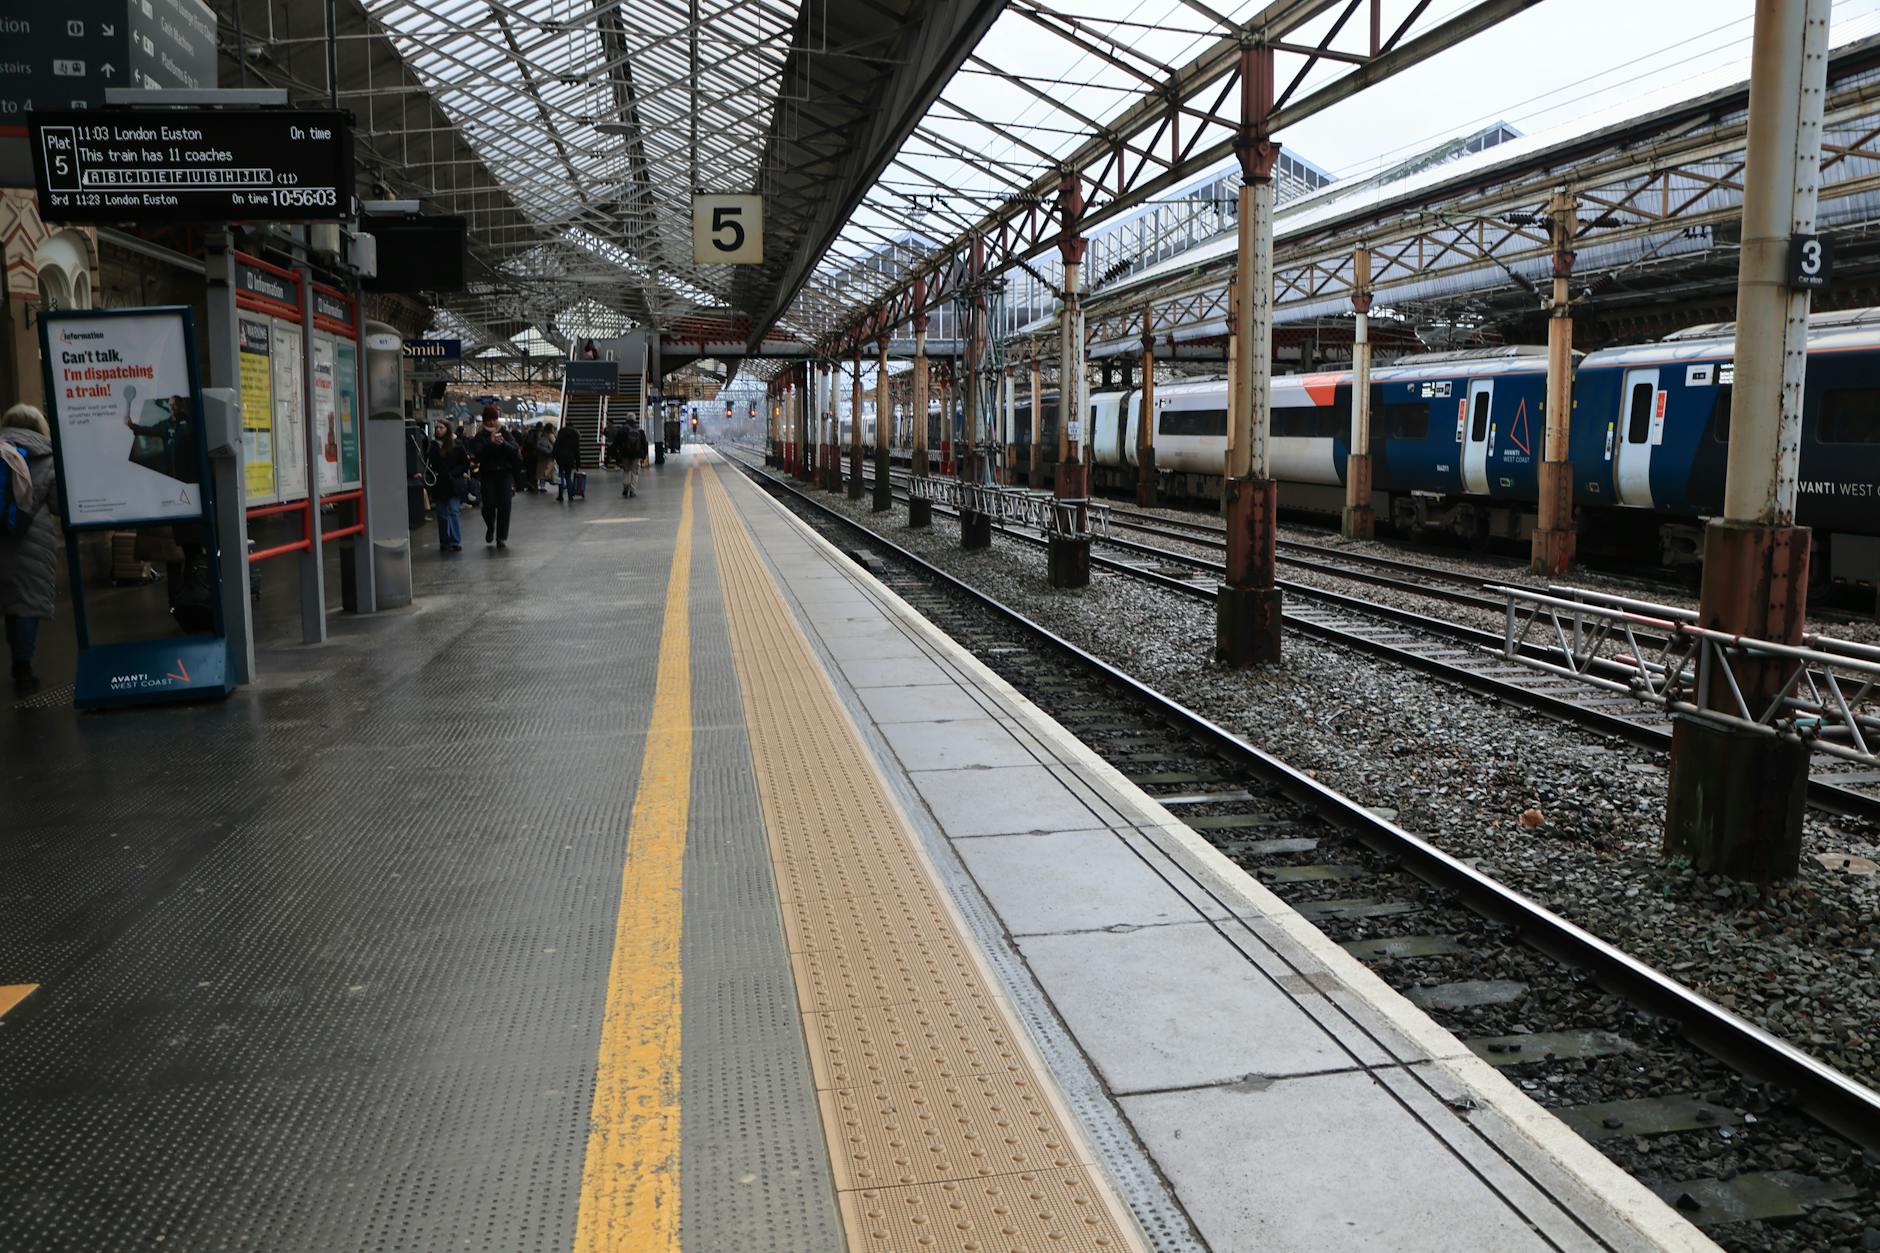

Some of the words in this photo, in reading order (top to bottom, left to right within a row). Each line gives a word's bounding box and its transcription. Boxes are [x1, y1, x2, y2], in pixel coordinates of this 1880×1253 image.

[1, 99, 18, 113] to
[23, 99, 34, 113] 4
[78, 126, 110, 141] 11:03
[114, 126, 157, 140] London
[161, 126, 202, 141] Euston
[291, 126, 305, 140] On
[310, 127, 332, 140] time
[47, 135, 72, 150] Plat
[80, 148, 104, 162] This
[108, 148, 138, 162] train
[142, 148, 164, 162] has
[169, 148, 180, 161] 11
[185, 148, 233, 162] coaches
[55, 155, 69, 176] 5
[277, 173, 297, 185] (11)
[50, 195, 69, 206] 3rd
[76, 195, 101, 206] 11:23
[105, 194, 141, 206] London
[143, 194, 178, 206] Euston
[232, 193, 245, 205] On
[248, 193, 269, 205] time
[271, 190, 337, 207] 10:56:03
[712, 207, 745, 252] 5
[1801, 240, 1822, 275] 3
[254, 274, 284, 299] Information
[1810, 276, 1823, 284] stop
[323, 300, 344, 320] Information
[62, 351, 93, 365] Can't
[96, 349, 123, 363] talk,
[64, 367, 82, 381] I'm
[84, 364, 154, 382] dispatching
[66, 389, 73, 398] a
[75, 383, 111, 397] train!
[694, 389, 702, 398] 5
[1839, 483, 1873, 497] WEST
[110, 682, 138, 691] WEST
[141, 678, 173, 688] COAST
[111, 674, 148, 683] AVANTI
